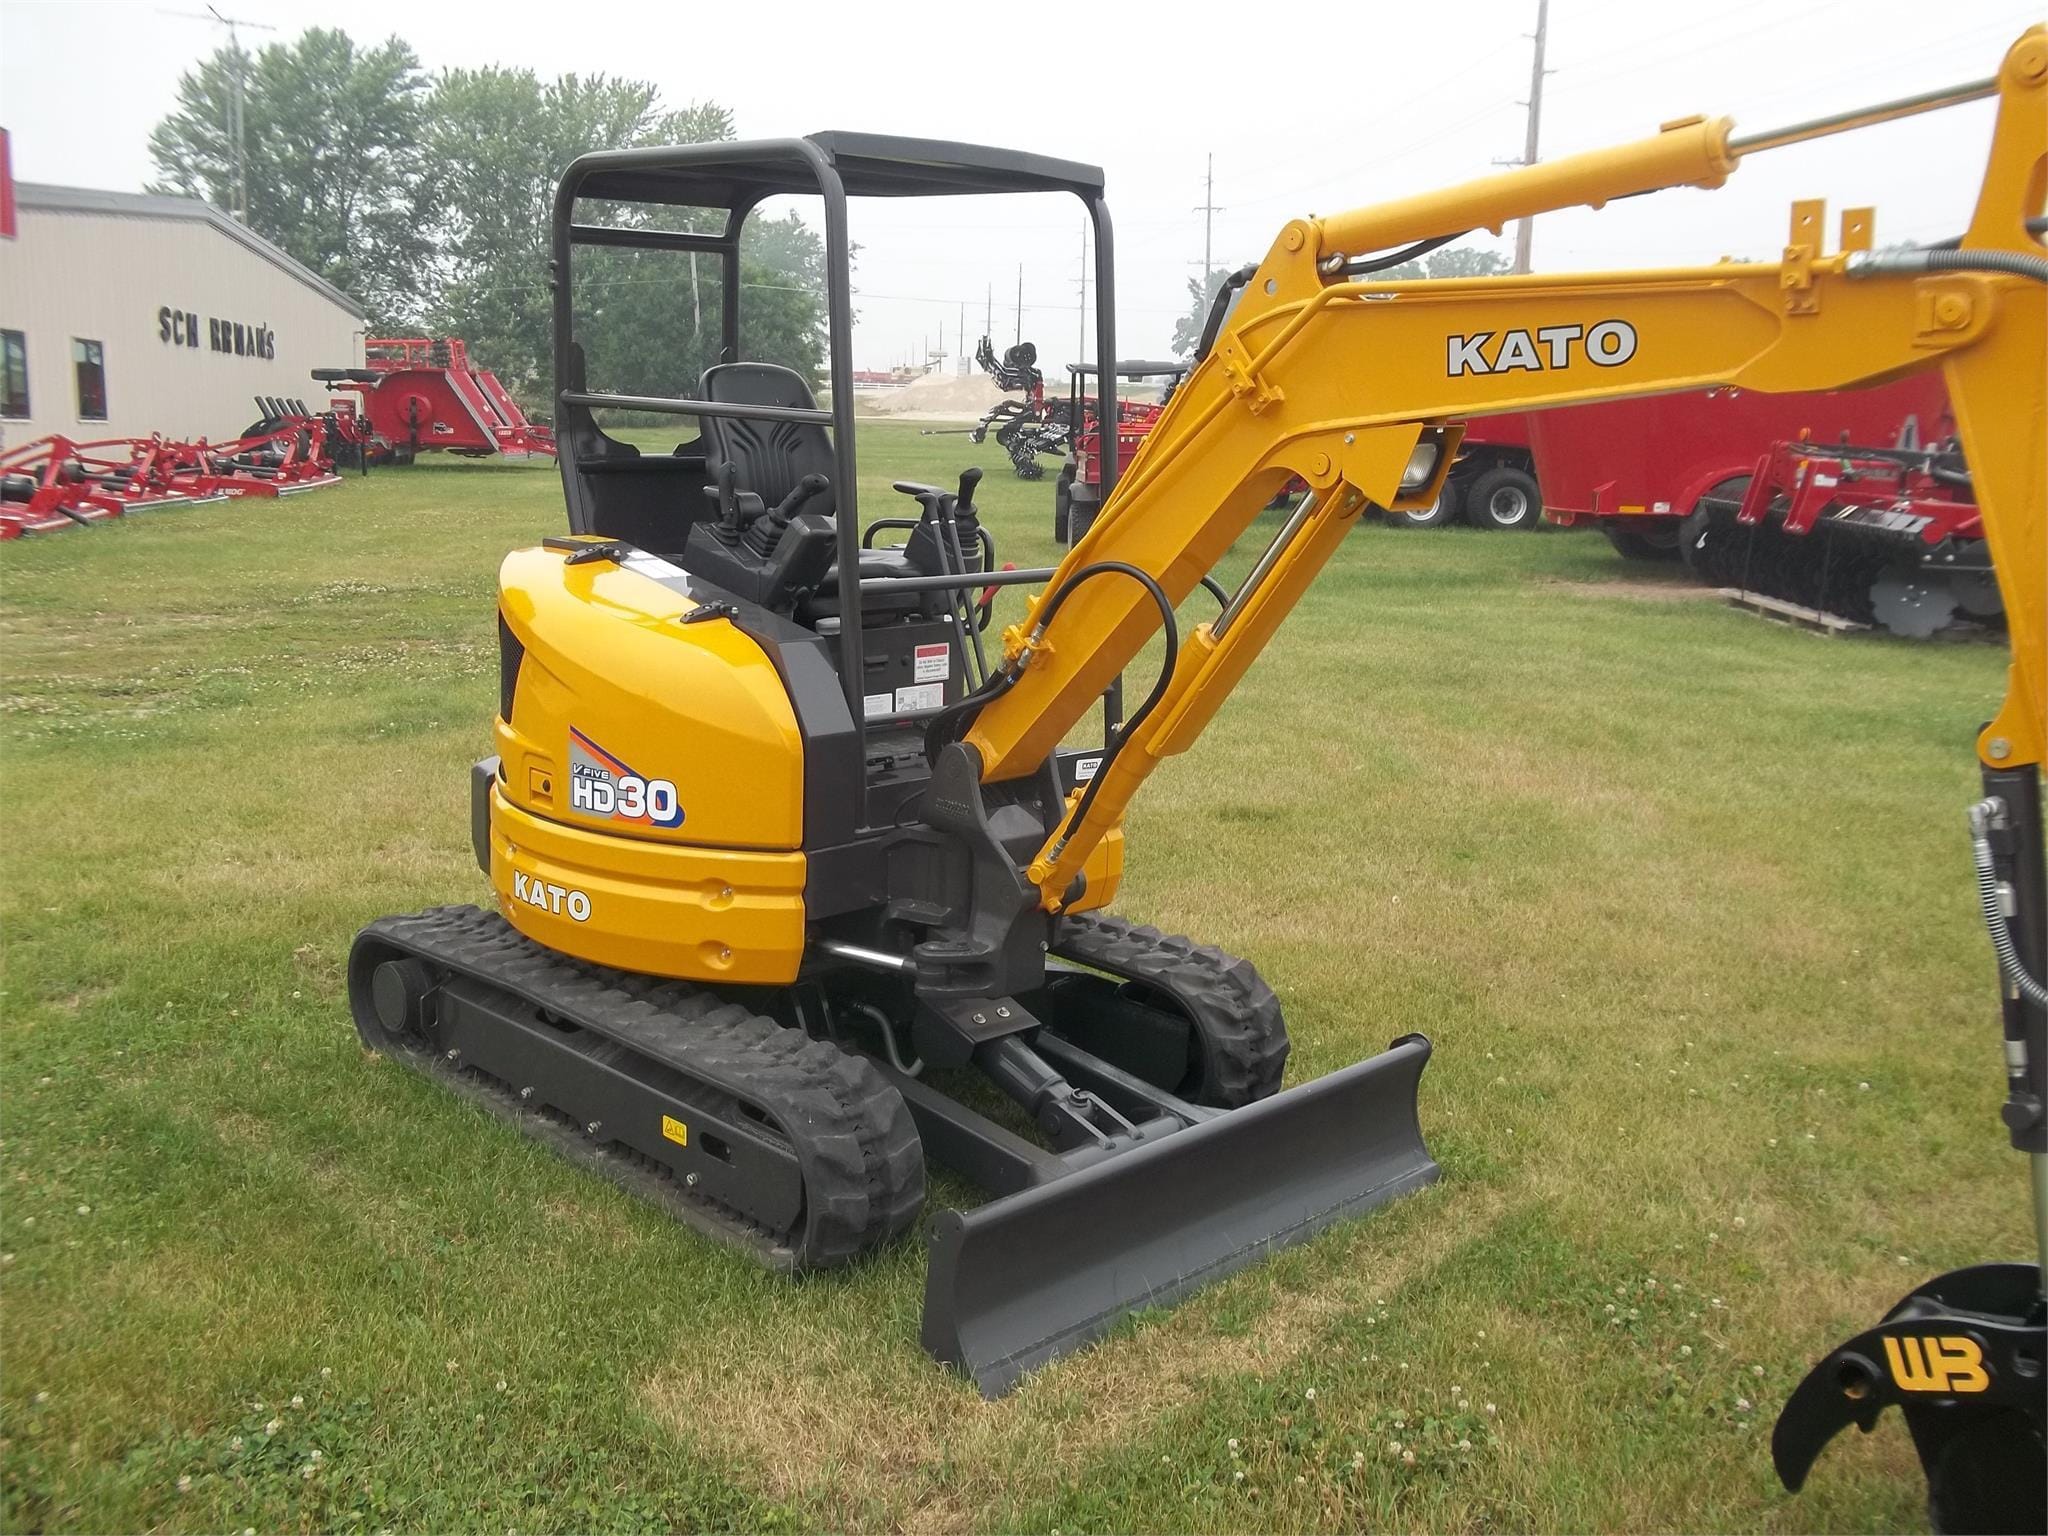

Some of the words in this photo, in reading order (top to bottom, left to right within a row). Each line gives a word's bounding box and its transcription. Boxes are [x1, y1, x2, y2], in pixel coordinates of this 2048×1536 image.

[1446, 318, 1639, 378] KATO
[573, 774, 678, 823] HD30
[513, 869, 593, 923] KATO
[1882, 1336, 1990, 1393] WB
